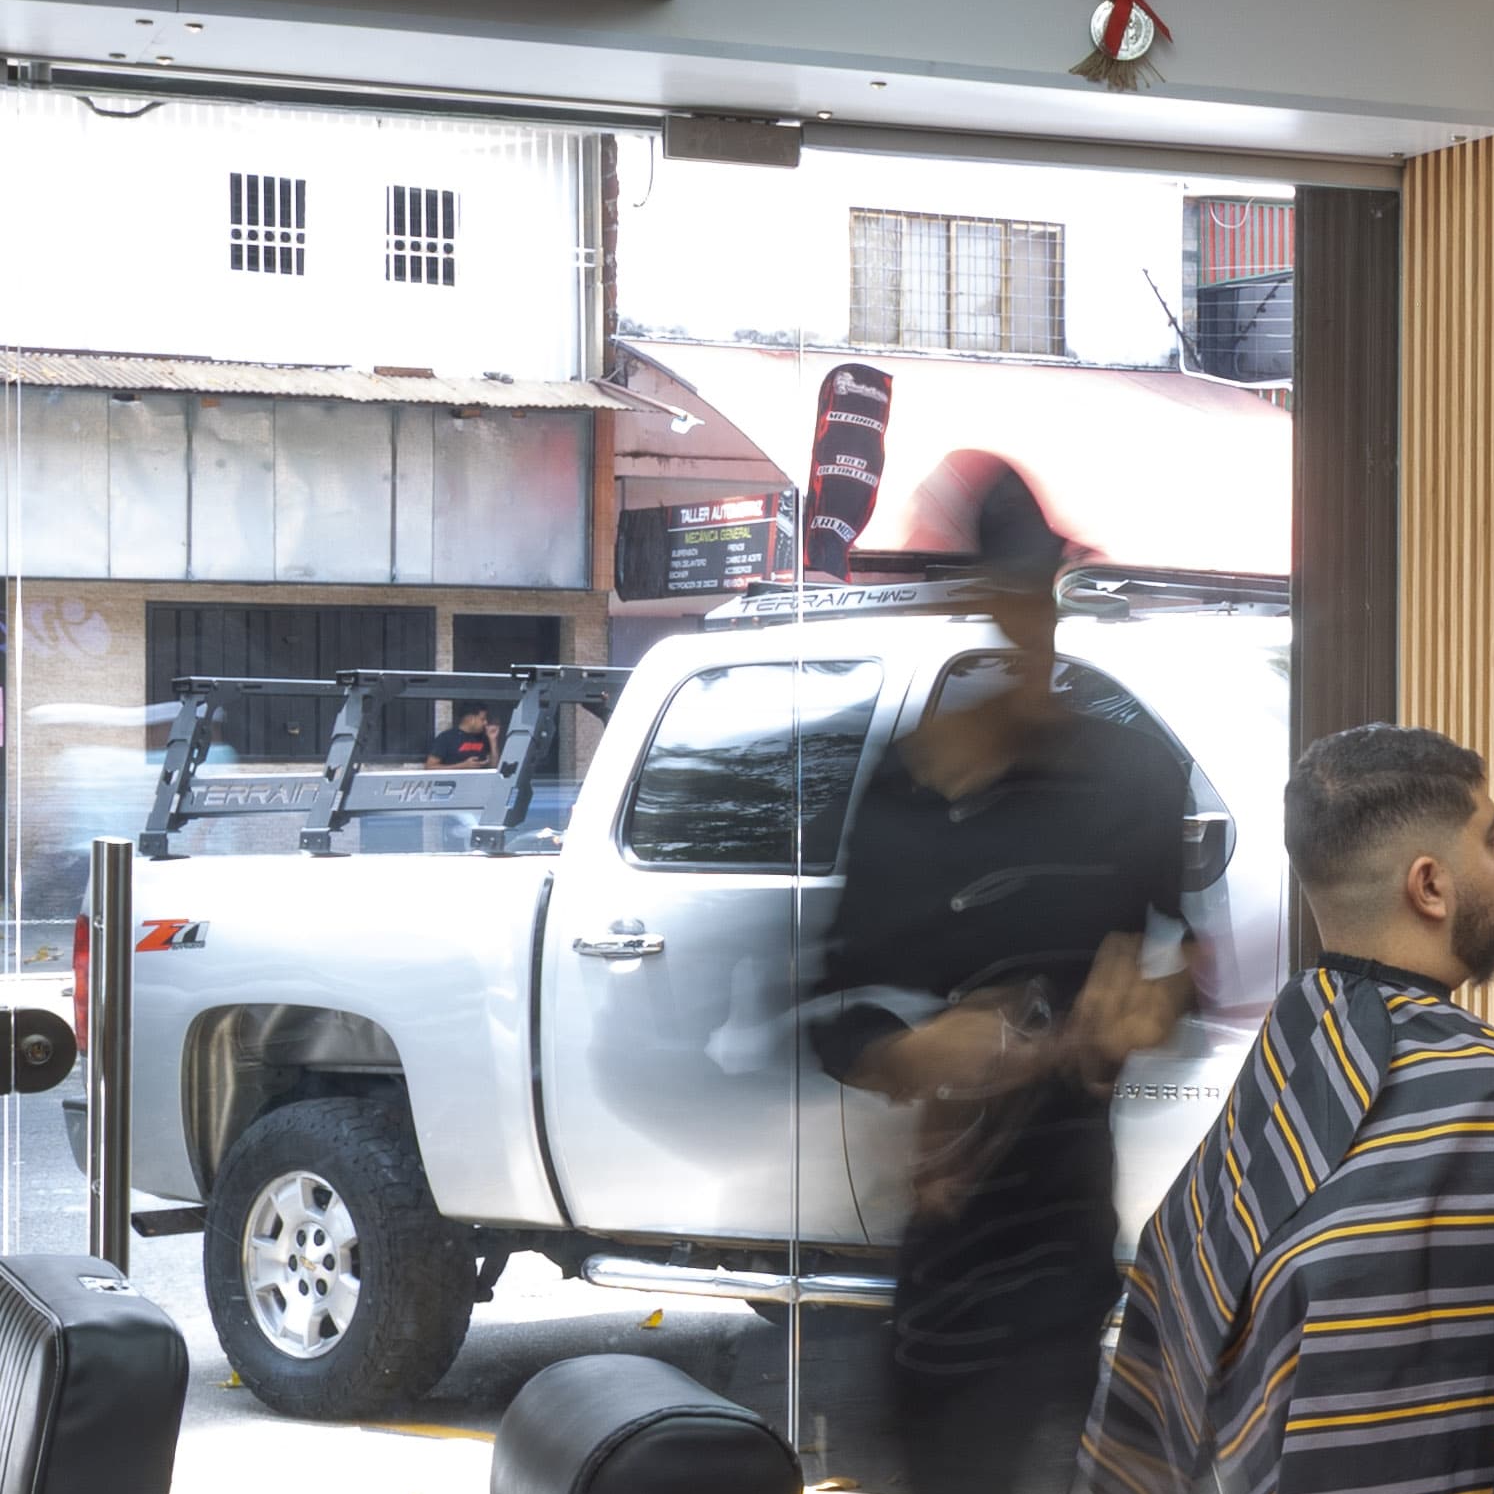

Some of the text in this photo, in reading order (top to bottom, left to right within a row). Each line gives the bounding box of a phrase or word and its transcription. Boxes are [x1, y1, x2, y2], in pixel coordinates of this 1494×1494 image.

[681, 506, 710, 523] TALLER
[740, 590, 917, 613] TERRAIN 4WD
[190, 780, 457, 806] TERRAIN 4WD
